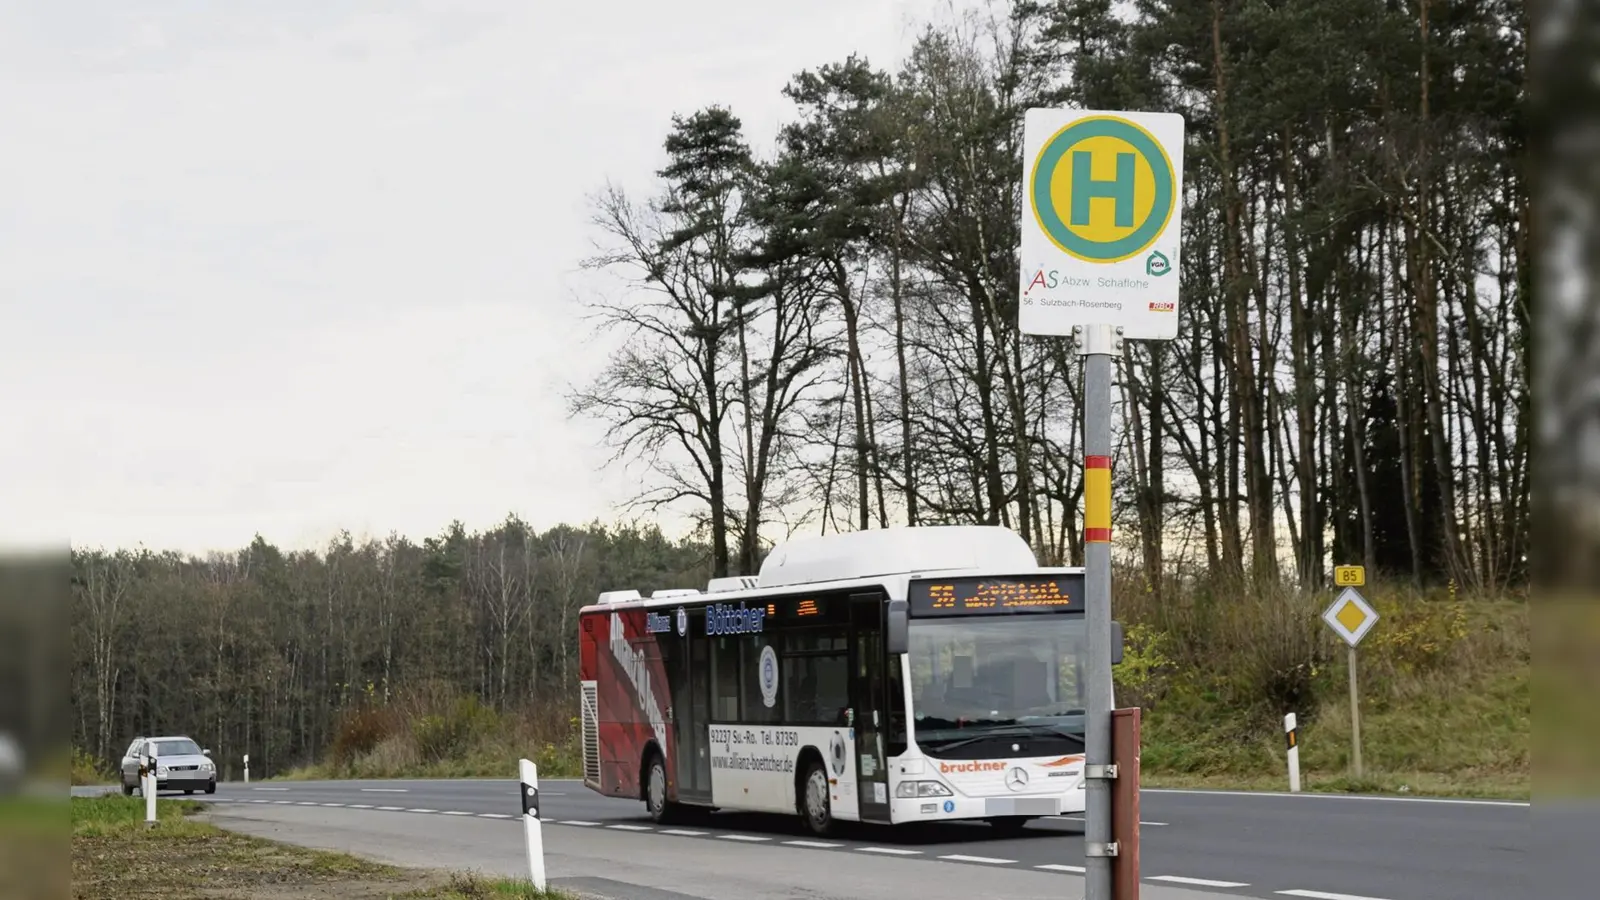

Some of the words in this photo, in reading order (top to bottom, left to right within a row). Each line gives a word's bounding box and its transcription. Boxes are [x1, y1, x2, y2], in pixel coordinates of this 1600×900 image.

[1071, 151, 1135, 227] H
[1040, 297, 1122, 311] Sulzbach-Rosenberg
[1343, 570, 1357, 581] 85
[706, 601, 766, 636] Böttcher
[711, 729, 732, 744] 92237
[760, 730, 775, 746] Tel.
[775, 730, 799, 747] 87350
[711, 751, 794, 774] www.allianz-boettcher.de
[939, 760, 1008, 774] bruckner
